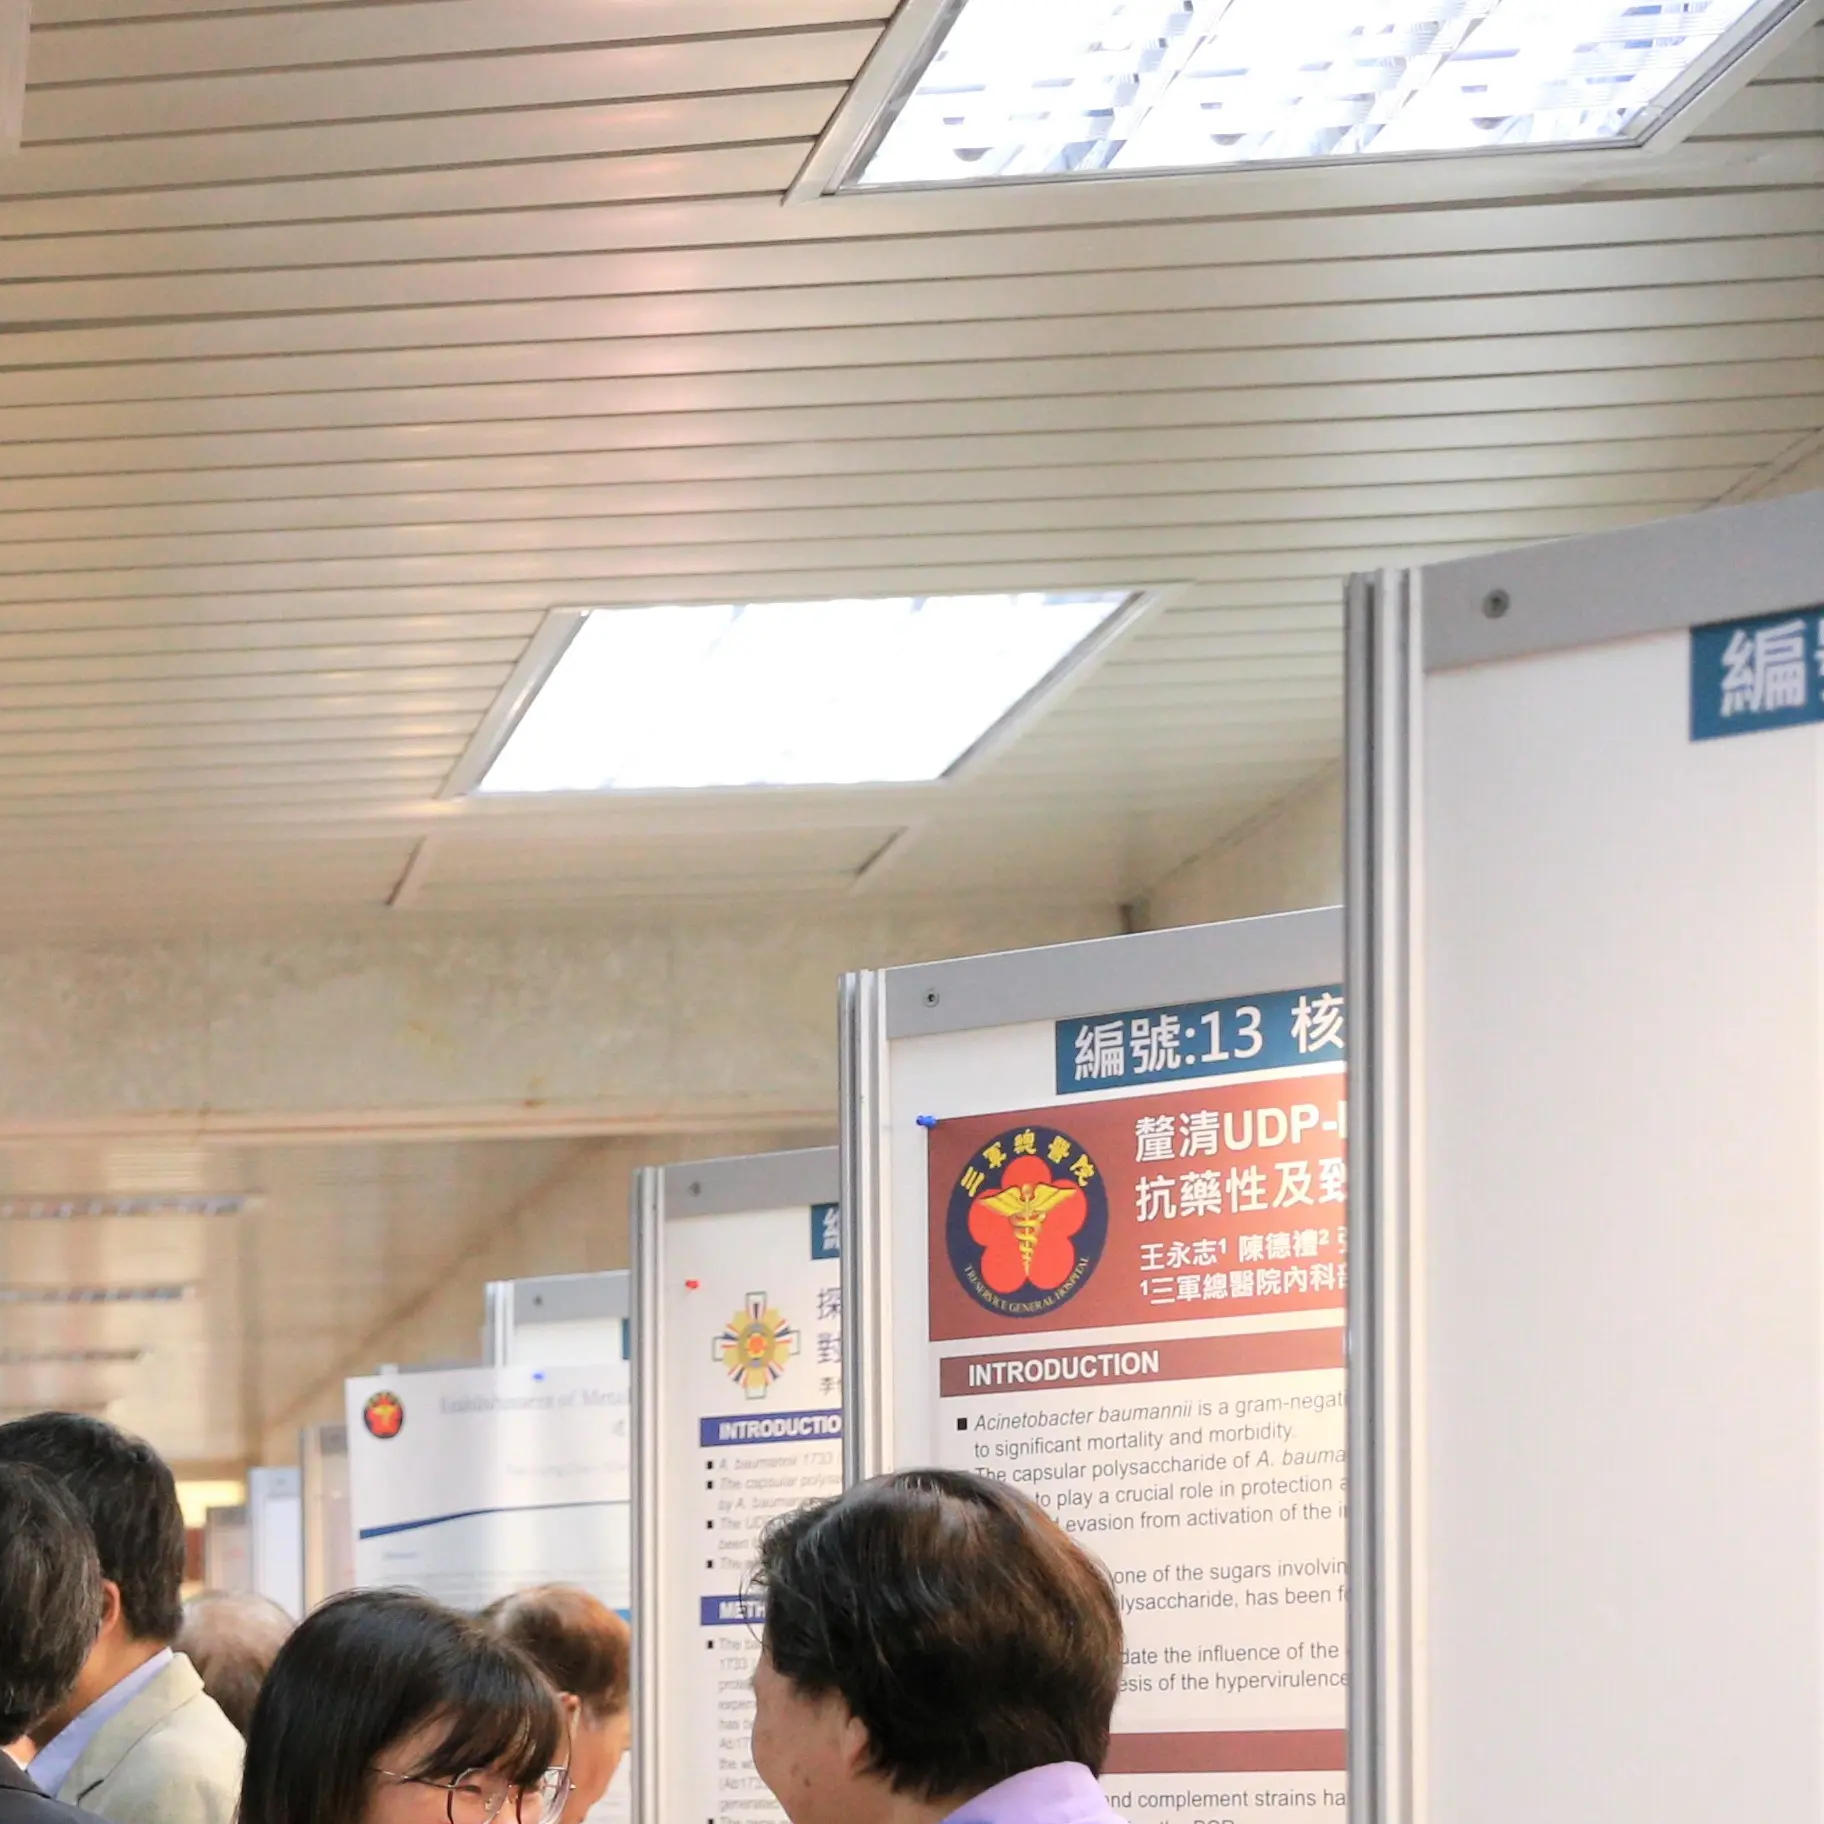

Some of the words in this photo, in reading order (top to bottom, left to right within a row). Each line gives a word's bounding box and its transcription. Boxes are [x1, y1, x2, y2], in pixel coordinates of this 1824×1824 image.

[1721, 620, 1824, 718] 編
[1291, 993, 1345, 1053] 核
[967, 1350, 1160, 1388] INTRODUCTION
[718, 1414, 841, 1440] INTRODUCTIO
[974, 1407, 1095, 1432] Acinetobacter
[1099, 1400, 1192, 1425] baumannii
[1198, 1399, 1212, 1416] is
[1218, 1401, 1229, 1414] a
[974, 1443, 990, 1459] to
[995, 1435, 1082, 1459] significant
[1087, 1429, 1162, 1454] mortality
[1169, 1428, 1203, 1446] and
[1012, 1461, 1086, 1483] capsular
[1092, 1452, 1227, 1480] polysaccharide
[1233, 1450, 1252, 1468] of
[1056, 1486, 1093, 1510] play
[1098, 1491, 1110, 1504] a
[1115, 1483, 1174, 1504] crucial
[1180, 1481, 1213, 1499] role
[1219, 1480, 1235, 1498] in
[1241, 1475, 1332, 1505] protection
[1065, 1513, 1134, 1534] evasion
[1140, 1510, 1180, 1529] from
[1186, 1505, 1274, 1526] activation
[1279, 1503, 1297, 1521] of
[1302, 1502, 1332, 1519] the
[1113, 1565, 1147, 1585] one
[1152, 1563, 1172, 1583] of
[1176, 1563, 1204, 1582] the
[1209, 1561, 1271, 1583] sugars
[1246, 1588, 1279, 1607] has
[1285, 1586, 1331, 1605] been
[1164, 1646, 1191, 1664] the
[1198, 1643, 1280, 1663] influence
[1286, 1642, 1306, 1660] of
[1310, 1642, 1339, 1659] the
[1158, 1674, 1177, 1692] of
[1181, 1672, 1209, 1691] the
[1138, 1790, 1249, 1812] complement
[1255, 1788, 1317, 1807] strains
